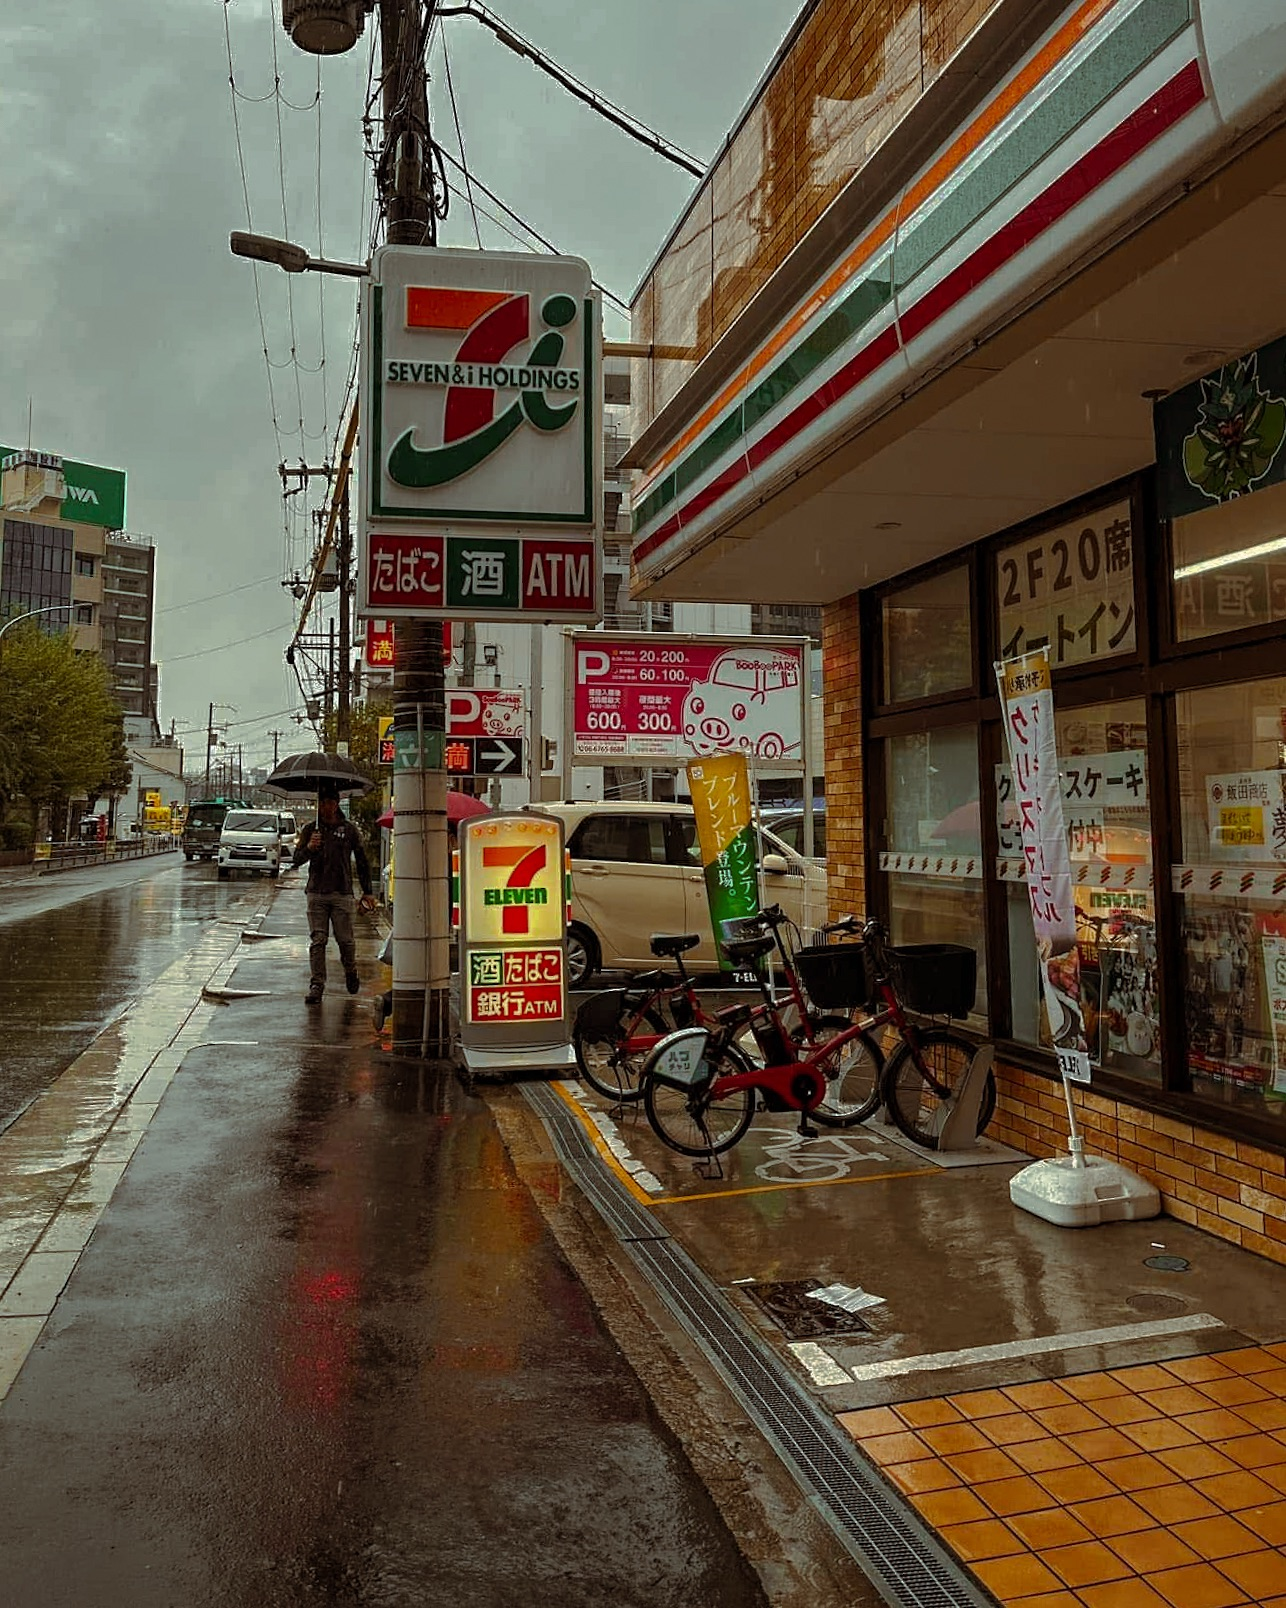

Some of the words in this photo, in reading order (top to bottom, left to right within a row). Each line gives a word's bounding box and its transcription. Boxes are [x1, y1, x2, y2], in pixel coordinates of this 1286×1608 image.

[479, 367, 580, 391] HOLDINGS
[372, 547, 441, 593] たばこ
[460, 550, 505, 596] 酒
[526, 553, 590, 598] ATM
[1002, 518, 1131, 608] 2F20席
[1002, 601, 1133, 664] イートイン
[578, 650, 611, 685] P
[723, 772, 757, 911] ブルーマウンテン
[473, 955, 501, 985] 酒
[506, 953, 560, 984] たばこ
